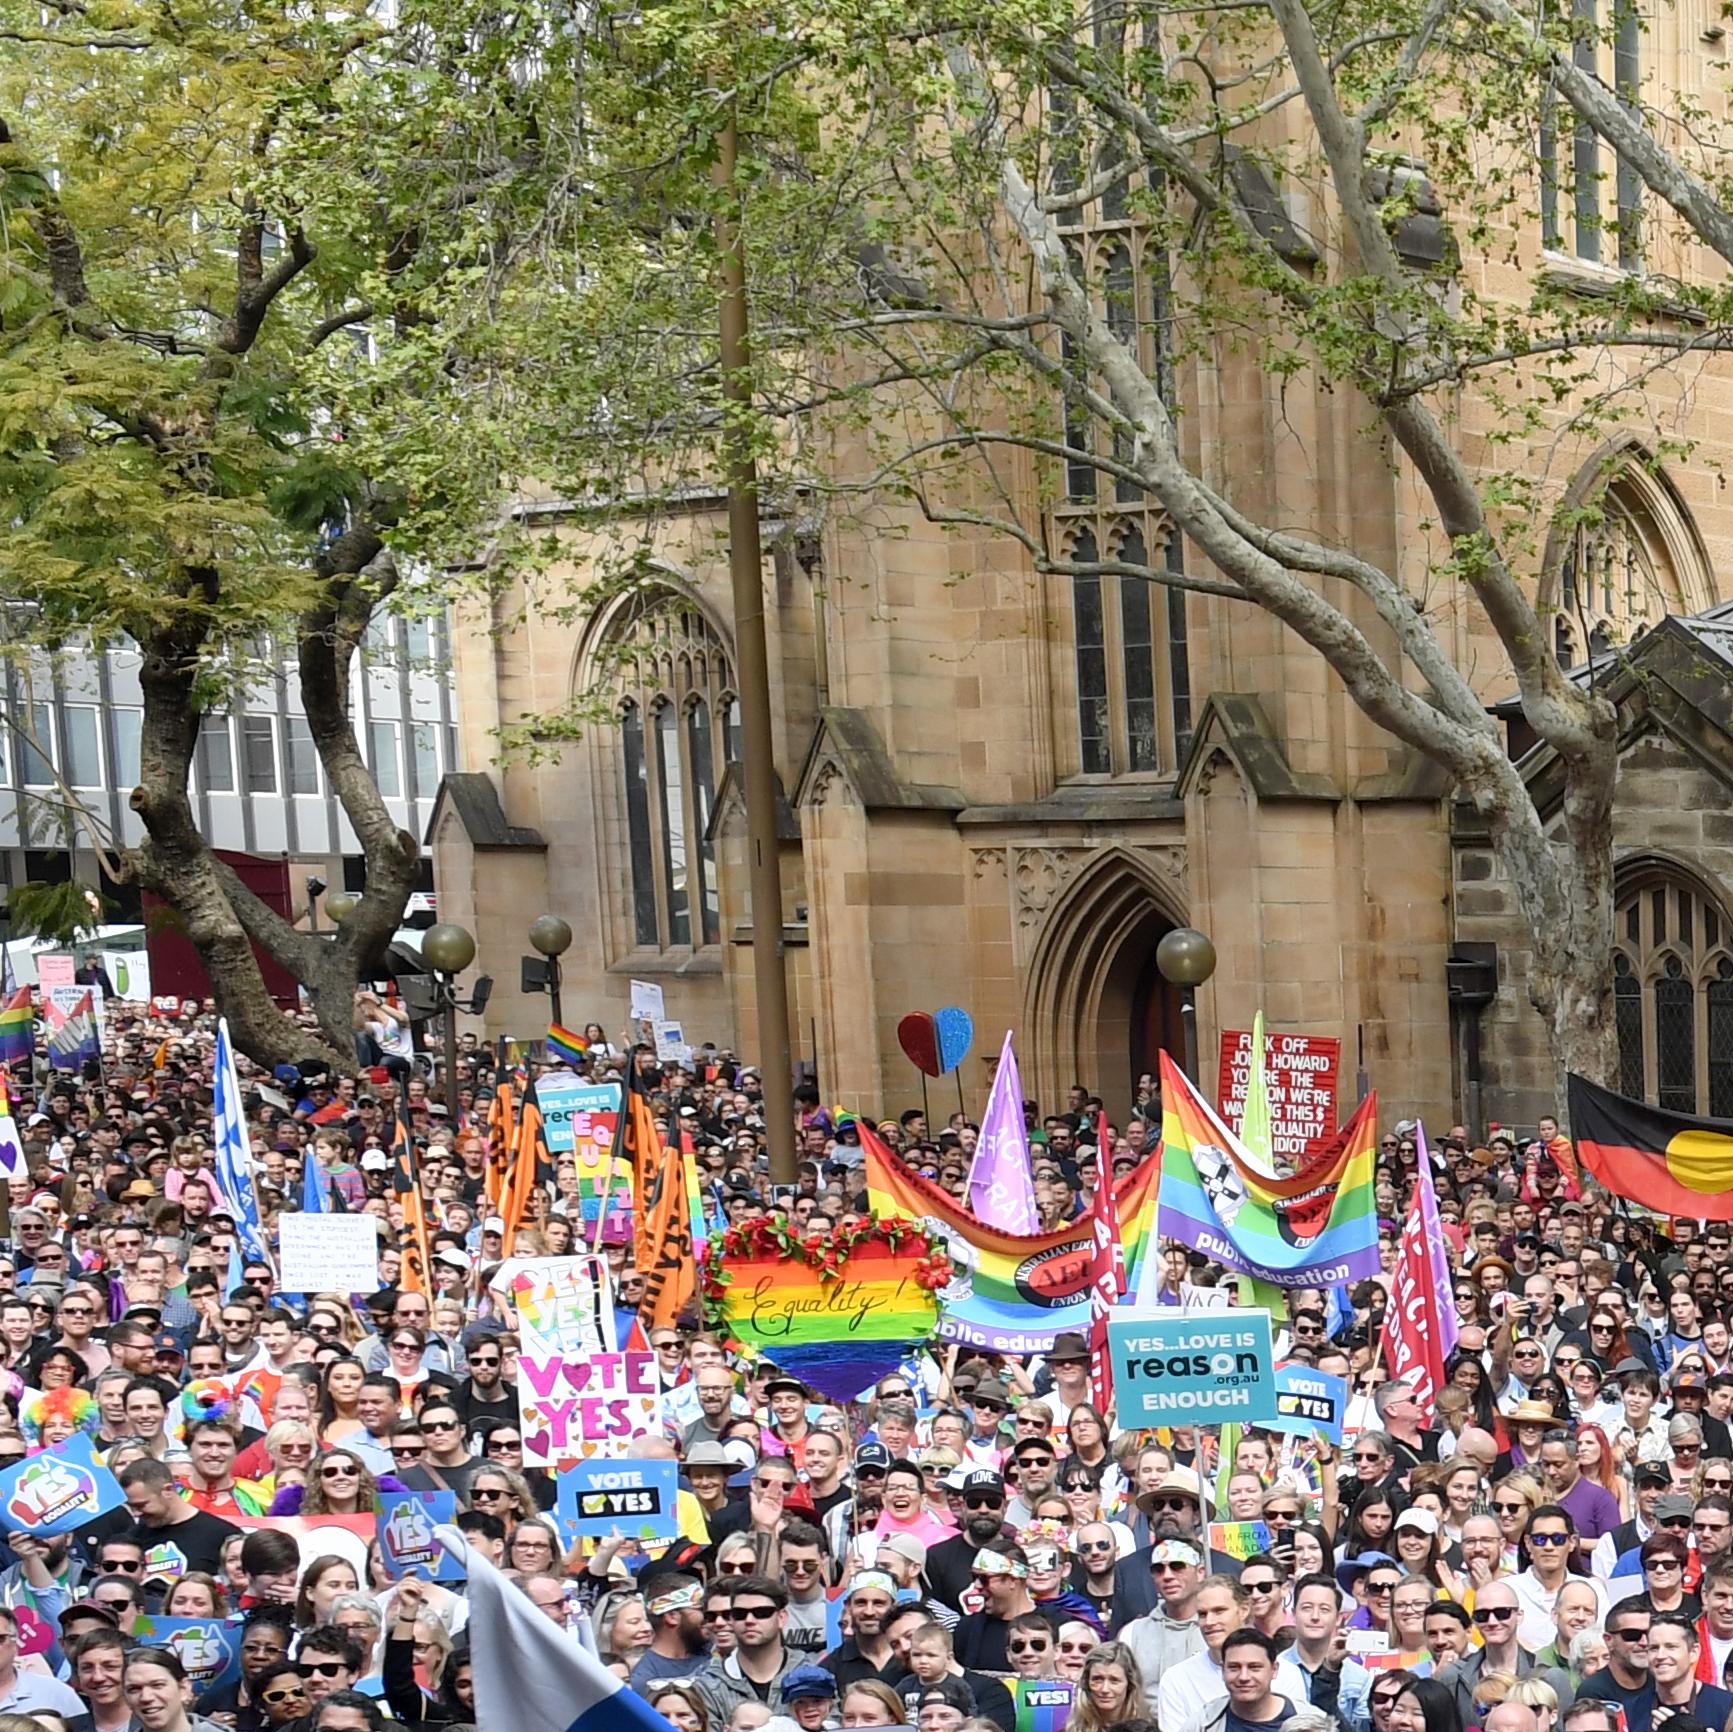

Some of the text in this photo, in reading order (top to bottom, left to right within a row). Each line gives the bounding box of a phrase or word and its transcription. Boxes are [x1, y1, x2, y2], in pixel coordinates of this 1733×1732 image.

[1239, 1034, 1308, 1054] FUK OFF
[1230, 1050, 1330, 1072] JO HOWARD
[1290, 1072, 1314, 1088] THE
[1284, 1104, 1314, 1121] THIS
[1274, 1137, 1307, 1154] IDIOT
[1236, 1332, 1255, 1347] IS
[1126, 1351, 1259, 1380] reason
[1287, 1377, 1327, 1398] VOTE
[1142, 1388, 1250, 1412] ENOUGH
[1301, 1399, 1330, 1418] YES
[586, 1470, 643, 1489] VOTE
[971, 1470, 996, 1486] LOVE
[24, 1464, 80, 1514] YES
[607, 1491, 653, 1513] YES
[391, 1514, 432, 1551] YES
[785, 1627, 825, 1645] NIKE
[1026, 1690, 1070, 1706] YES!
